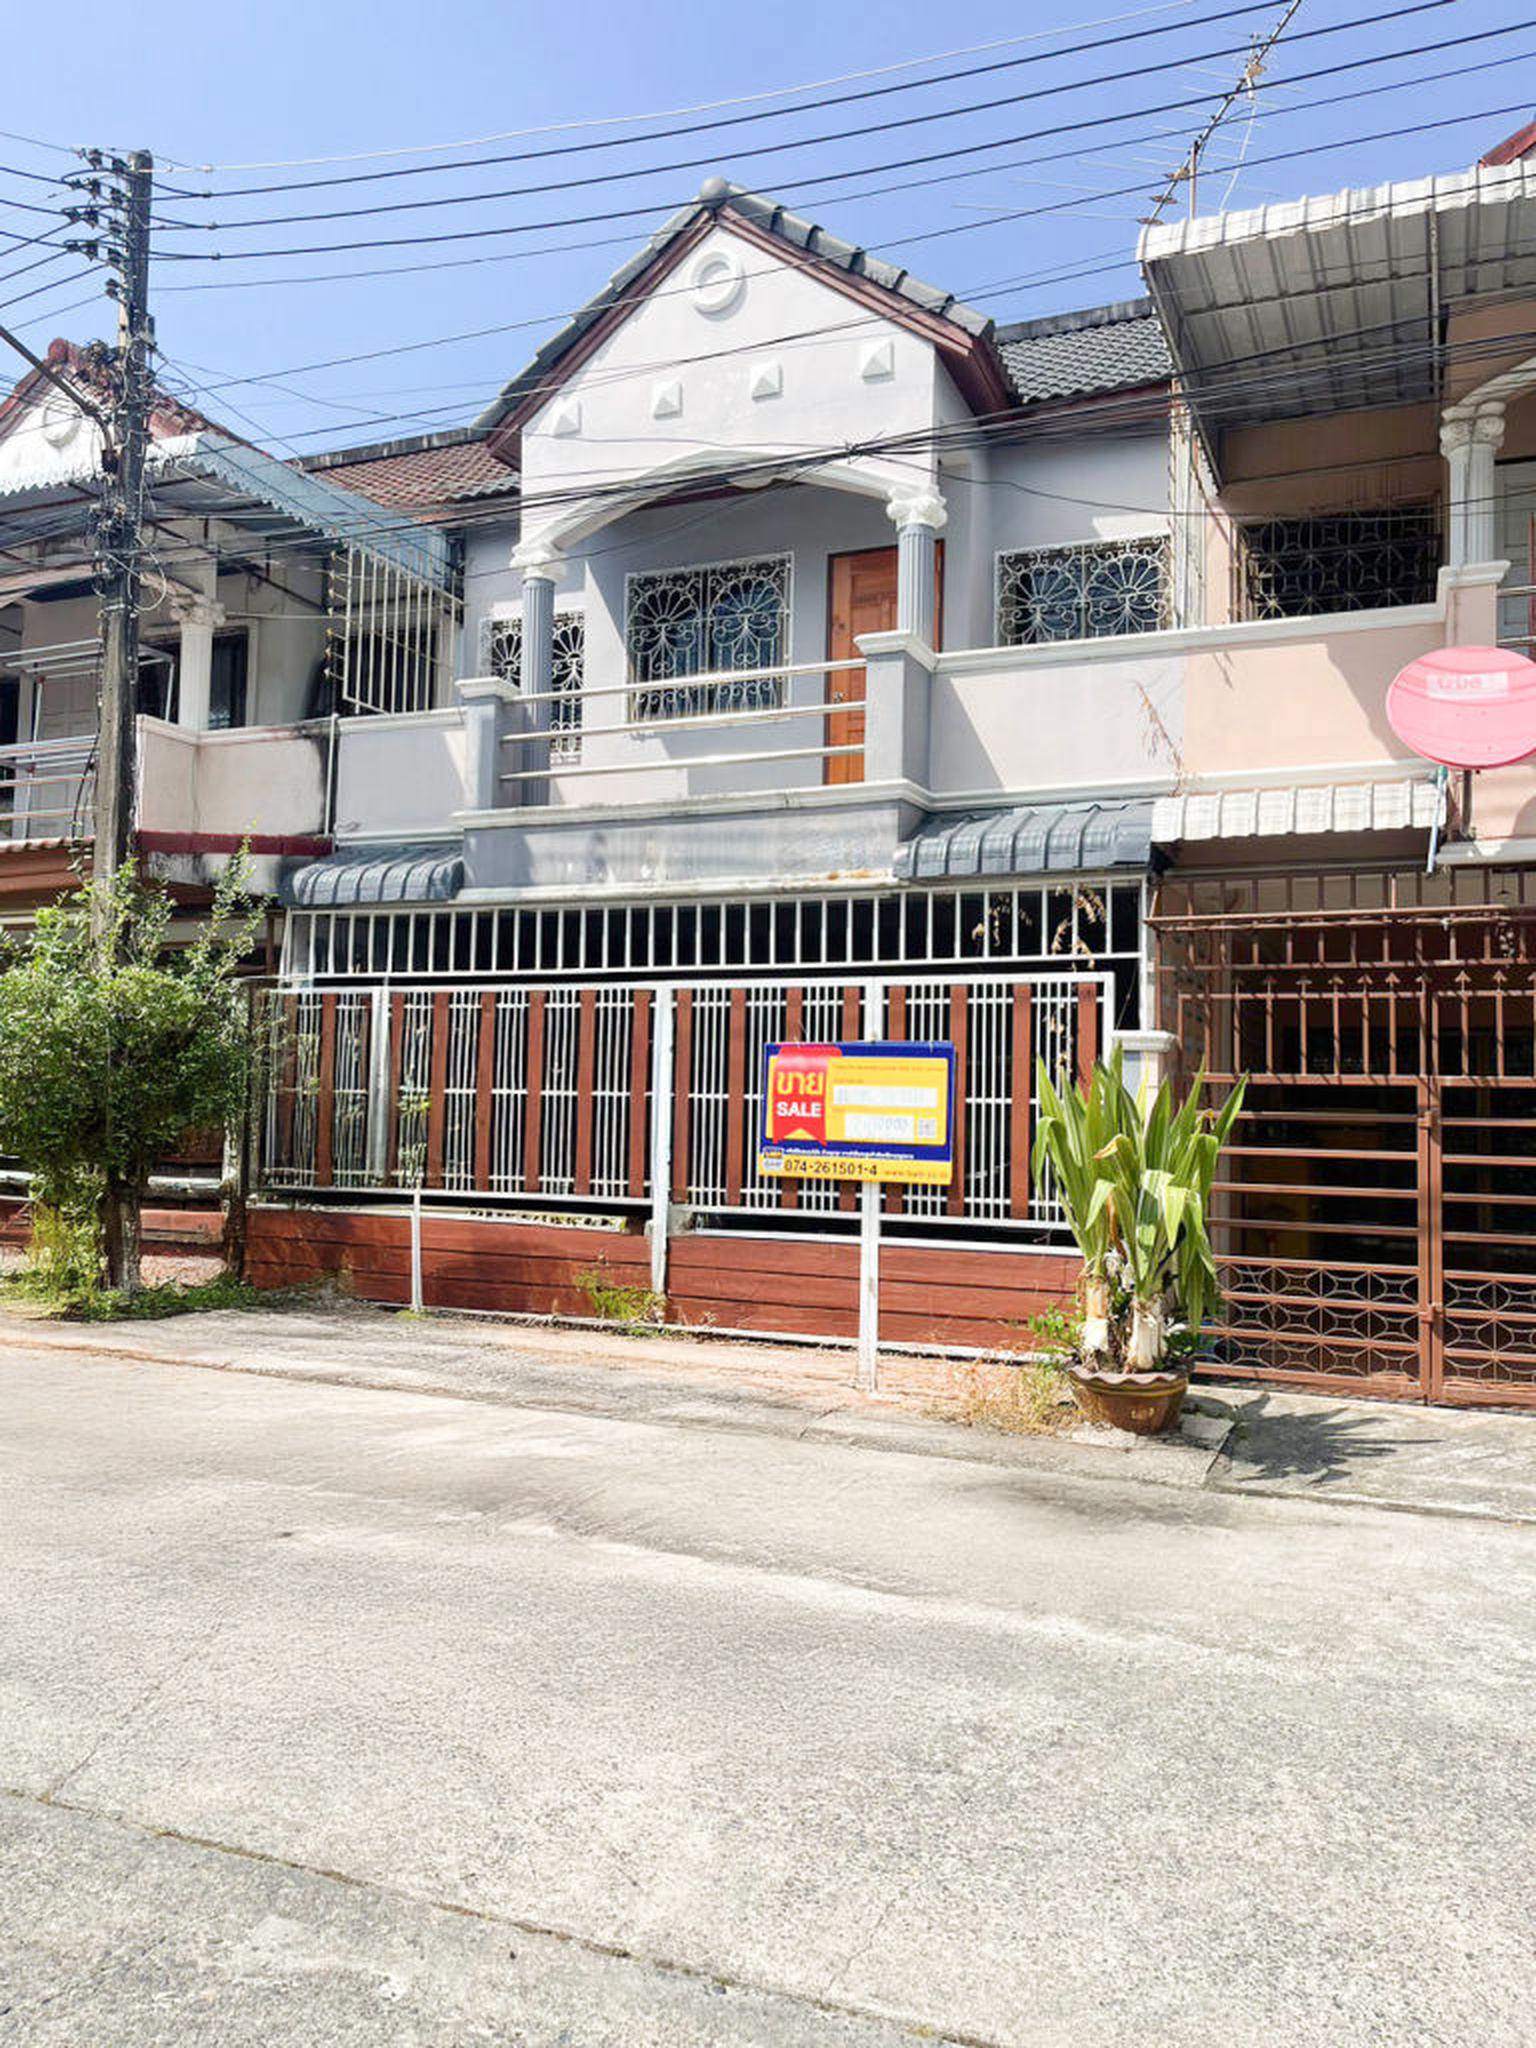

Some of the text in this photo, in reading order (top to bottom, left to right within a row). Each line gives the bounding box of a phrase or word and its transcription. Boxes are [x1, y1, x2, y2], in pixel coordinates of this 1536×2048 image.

[777, 1071, 824, 1095] ขาย
[776, 1102, 821, 1117] SALE
[784, 1158, 878, 1176] 074-261501-4
